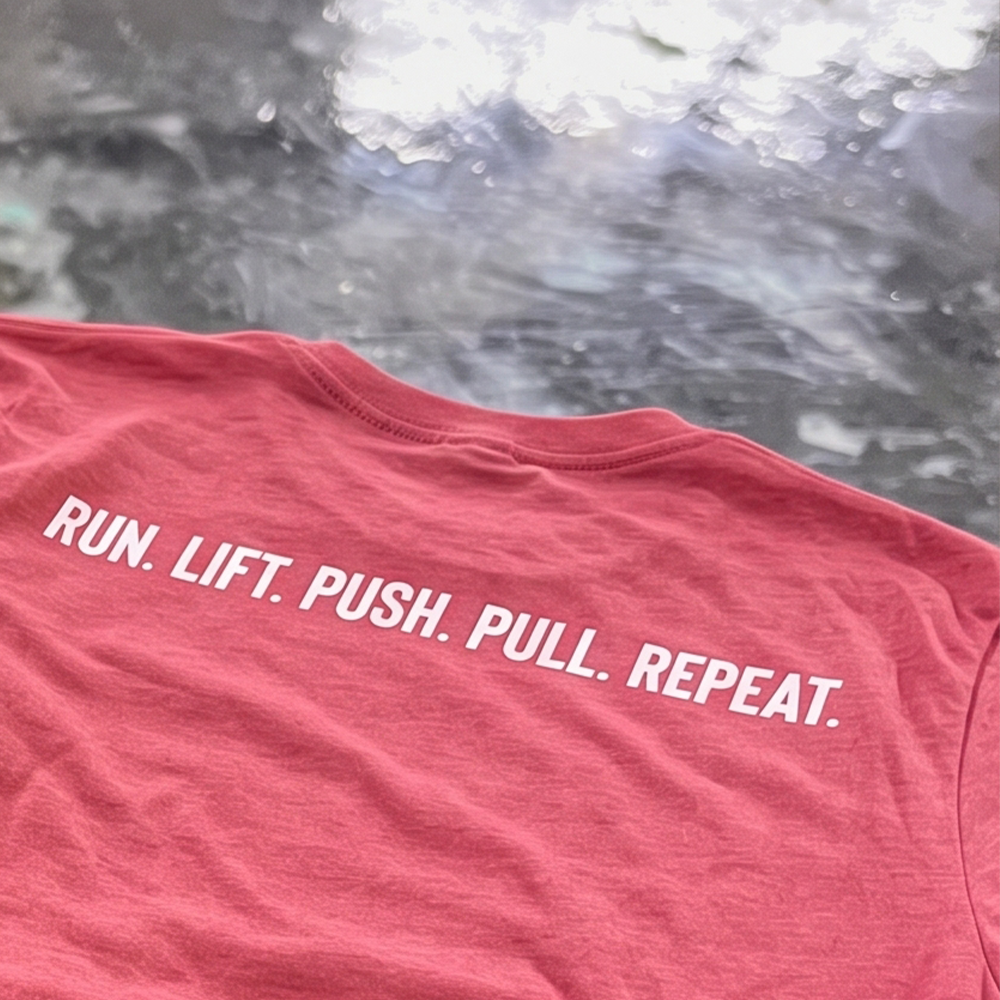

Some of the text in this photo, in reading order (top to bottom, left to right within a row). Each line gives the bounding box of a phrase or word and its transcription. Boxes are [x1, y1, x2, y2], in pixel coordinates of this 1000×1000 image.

[43, 495, 844, 728] RUN. LIFT. PUSH. PULL. REPEAT.
